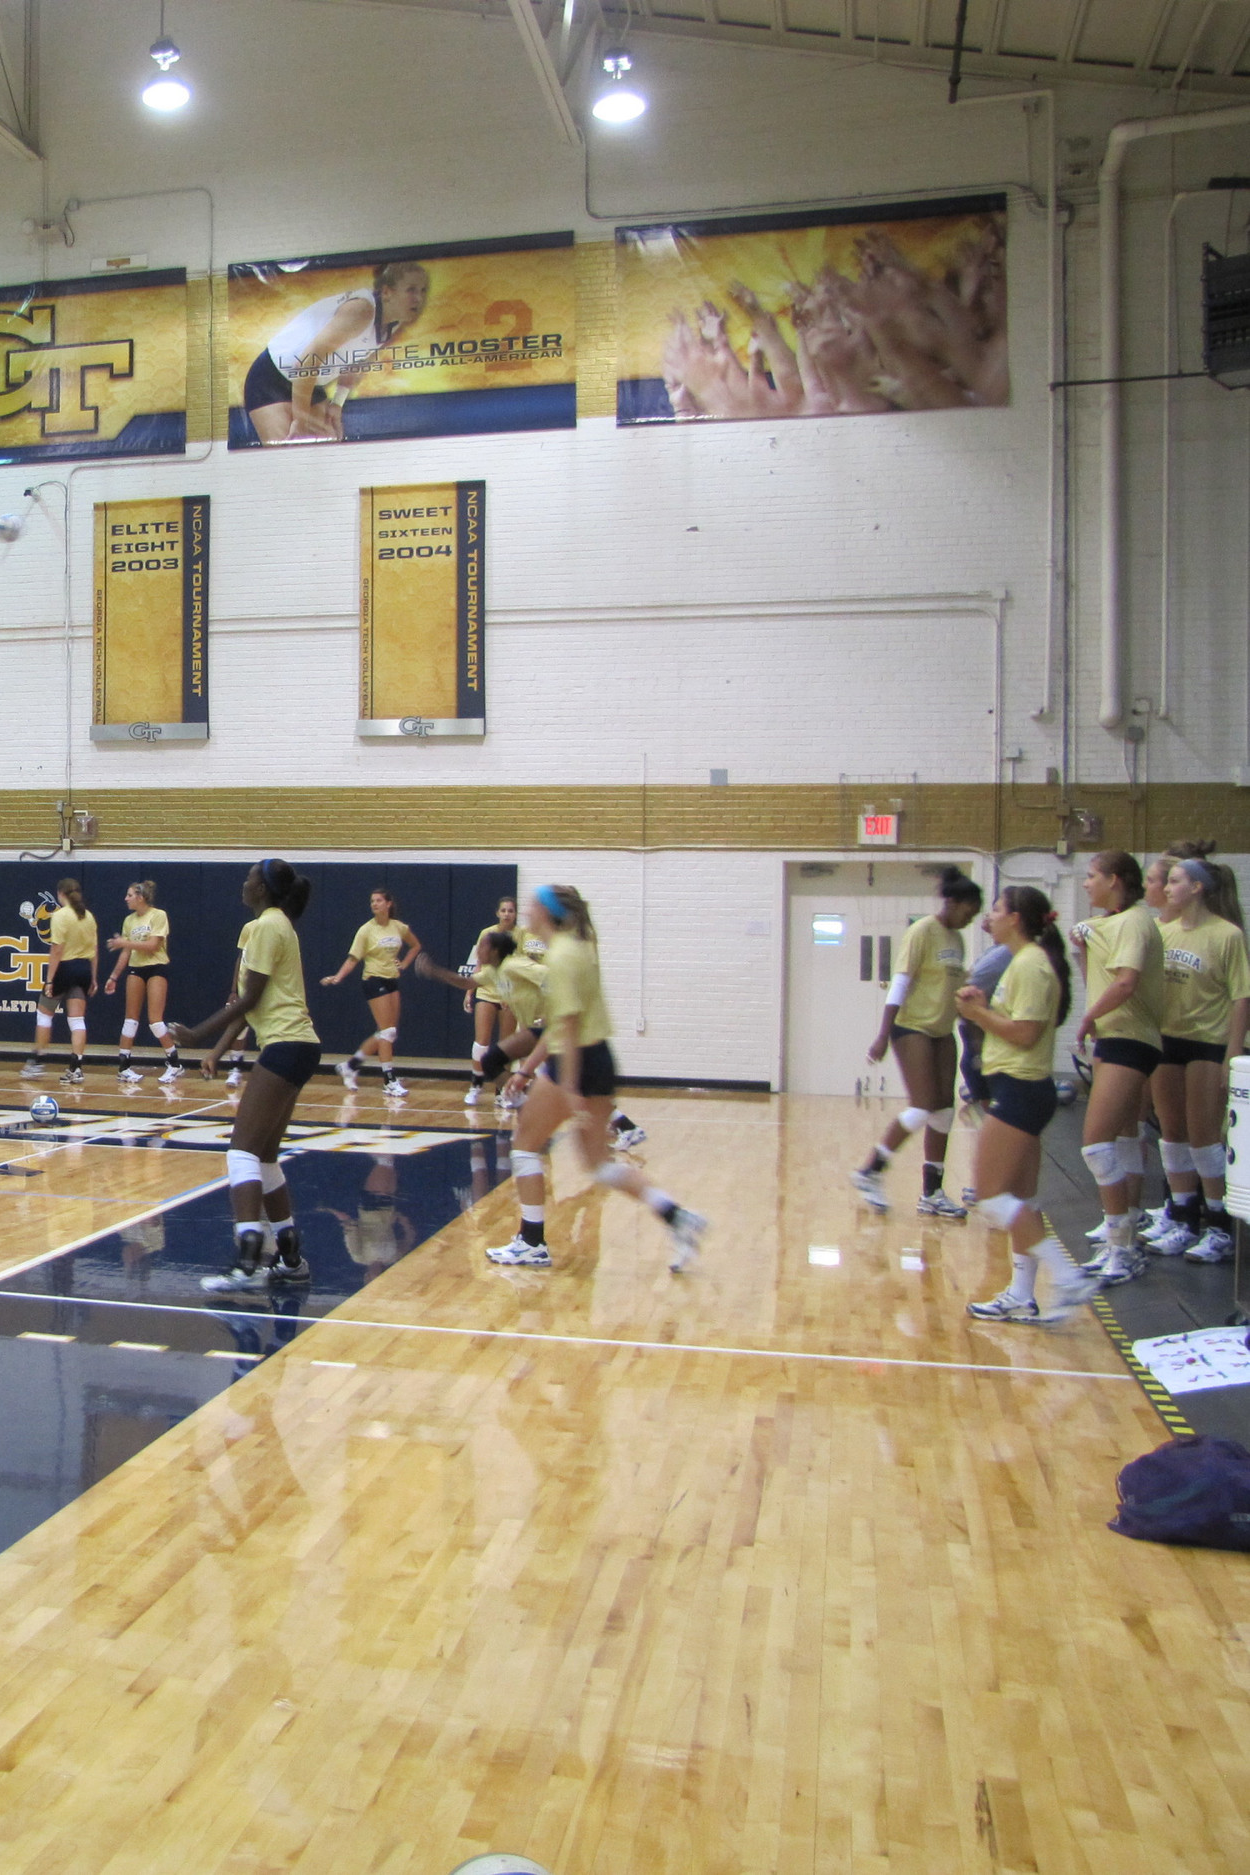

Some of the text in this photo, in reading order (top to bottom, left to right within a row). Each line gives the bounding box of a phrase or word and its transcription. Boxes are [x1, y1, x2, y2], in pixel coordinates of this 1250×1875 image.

[483, 299, 534, 372] 2
[278, 333, 563, 370] LYNNETTE MOSTER
[287, 350, 563, 379] 2002 2003 2004 ALL-AMERICAN
[378, 506, 453, 520] SWEET
[111, 521, 179, 536] ELITE
[378, 527, 453, 539] SIXTEEN
[111, 540, 179, 554] EIGHT
[378, 545, 453, 560] 2004
[111, 558, 179, 573] 2003
[192, 505, 202, 697] NCAA TOURNAMENT
[467, 491, 479, 692] NCAA TOURNAMENT
[128, 721, 162, 743] GT
[398, 716, 434, 738] GT
[865, 816, 893, 835] EXIT
